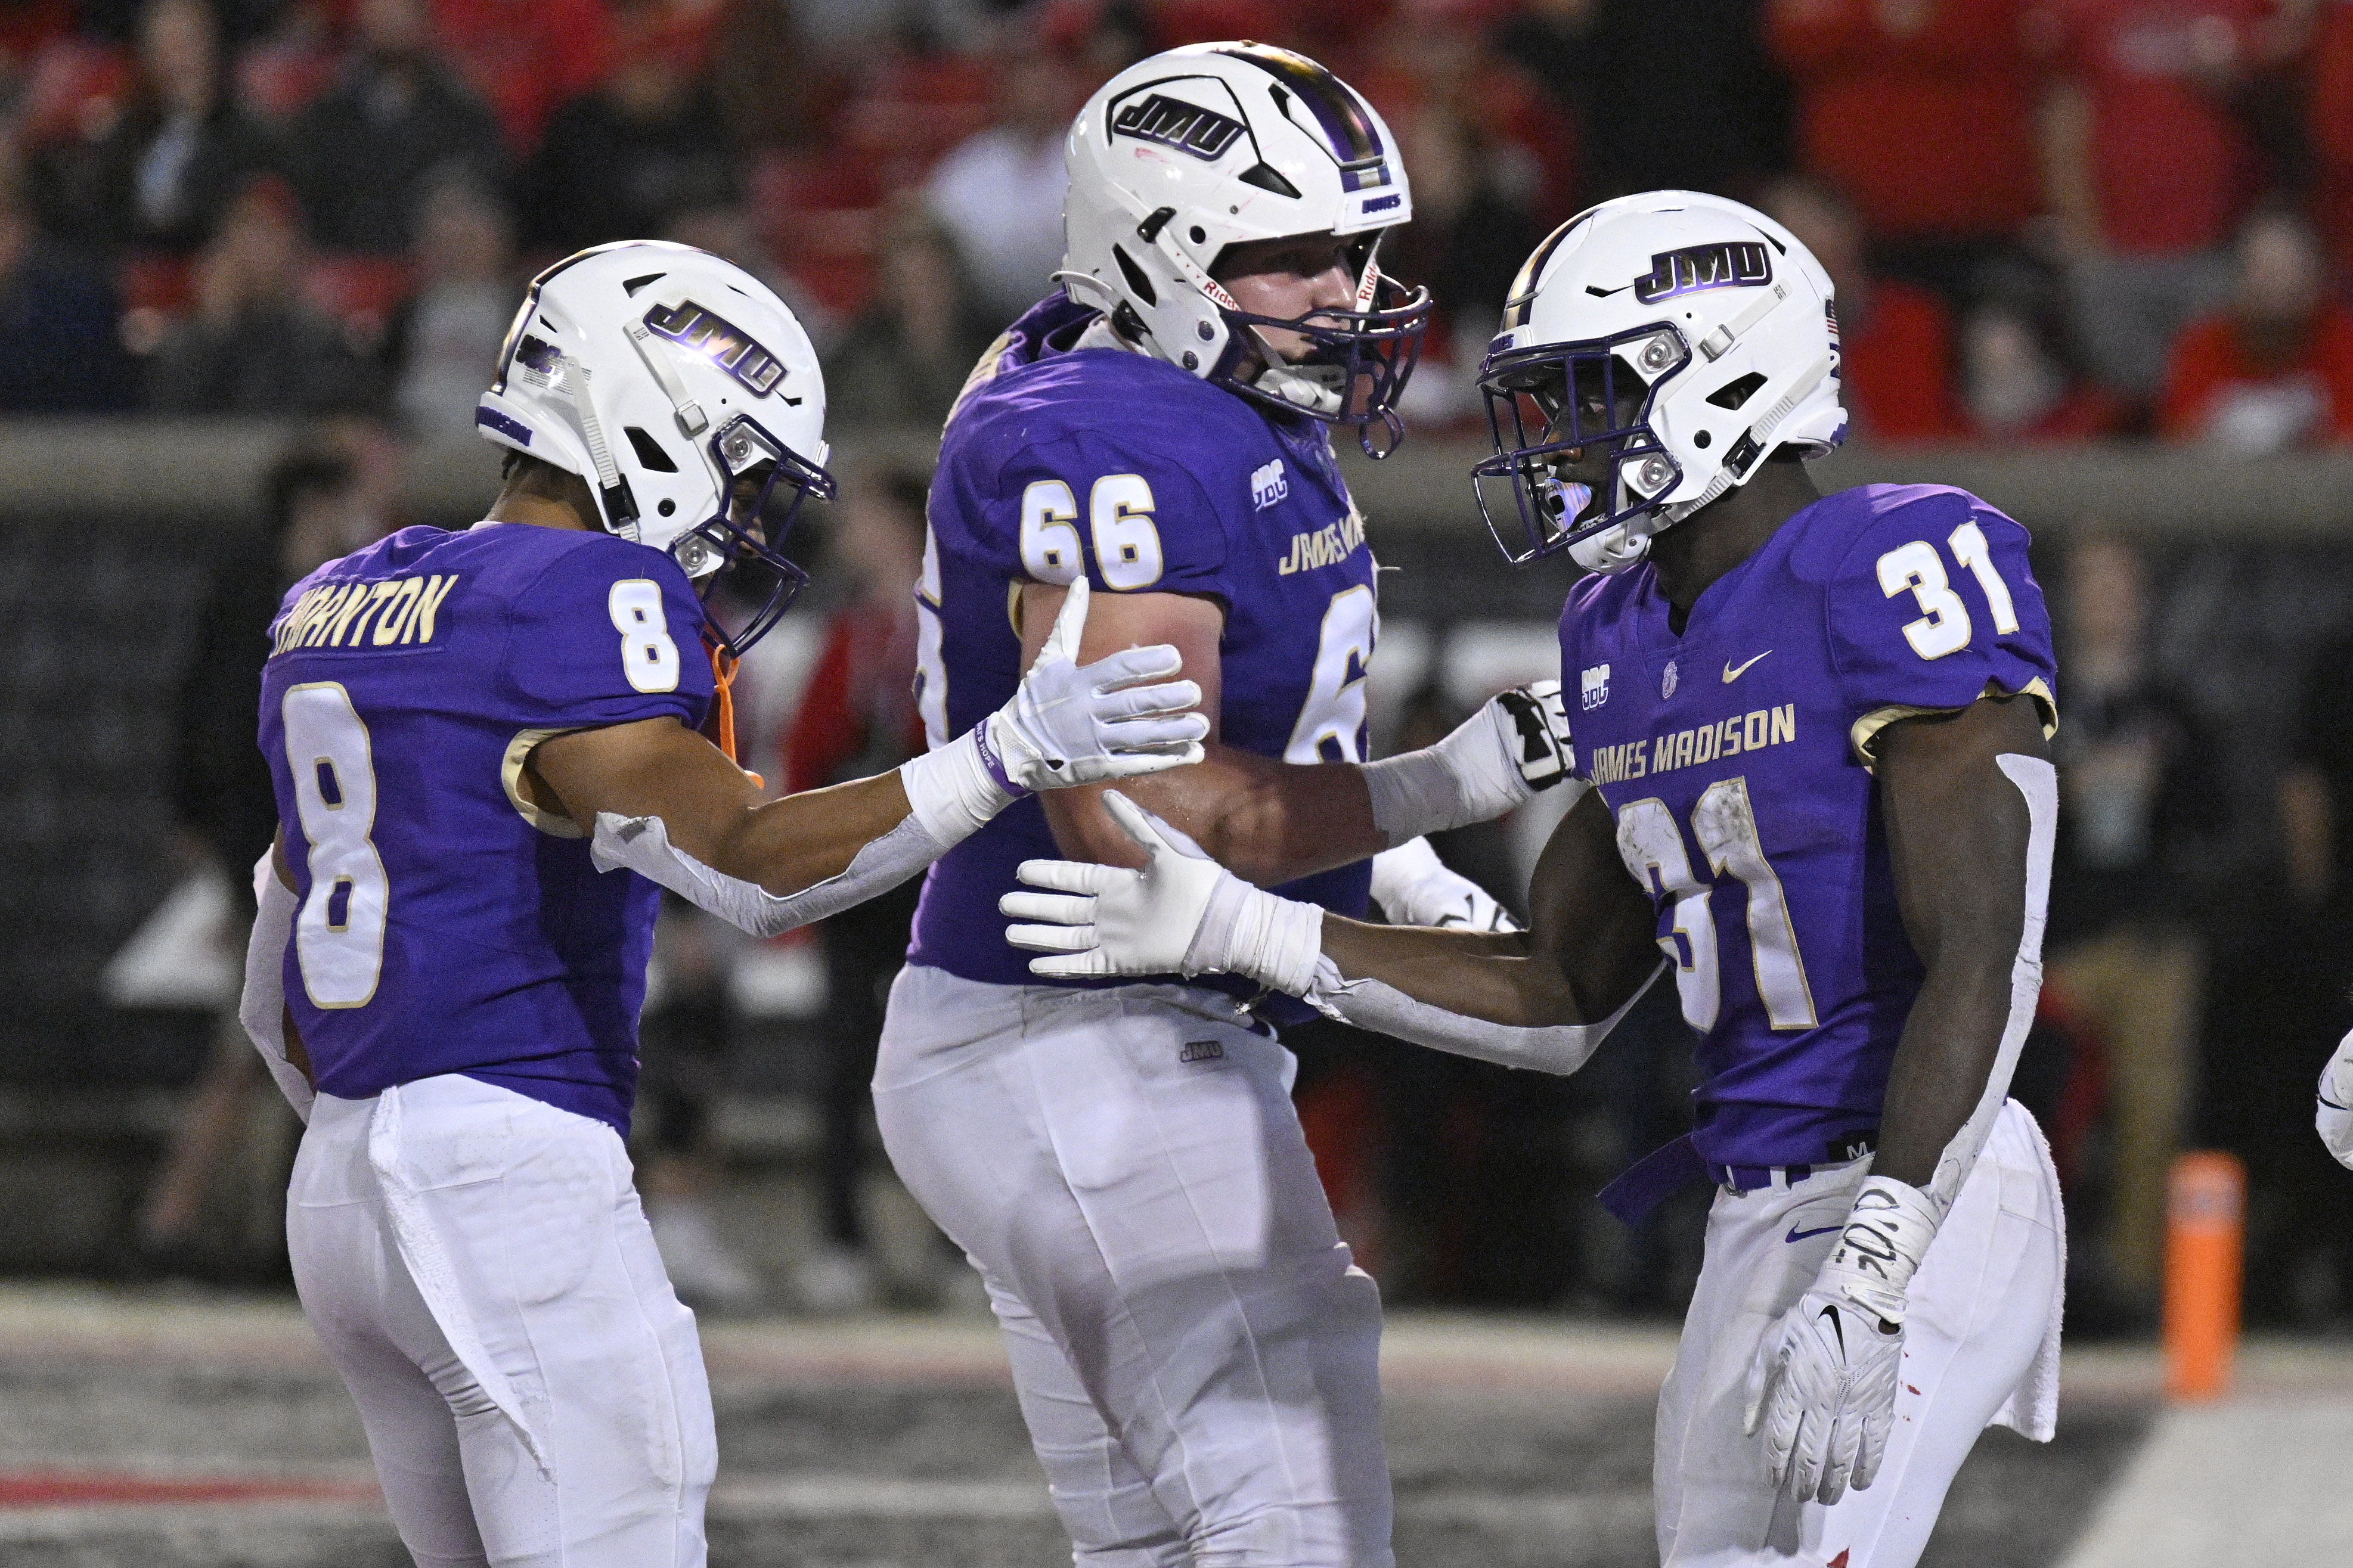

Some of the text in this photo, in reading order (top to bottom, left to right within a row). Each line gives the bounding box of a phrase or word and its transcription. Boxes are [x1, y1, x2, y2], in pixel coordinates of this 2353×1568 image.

[1114, 94, 1247, 162] JMU
[1635, 241, 1772, 305] JMU
[643, 299, 788, 398] JMU
[1020, 474, 1164, 591] 66
[609, 579, 680, 693] 8
[1877, 521, 2019, 660] 31
[979, 743, 995, 769] HOPE
[1591, 703, 1795, 787] JAMES MADISON
[283, 681, 389, 1009] 8
[1616, 776, 1818, 1035] 31
[1180, 1041, 1223, 1063] JMU
